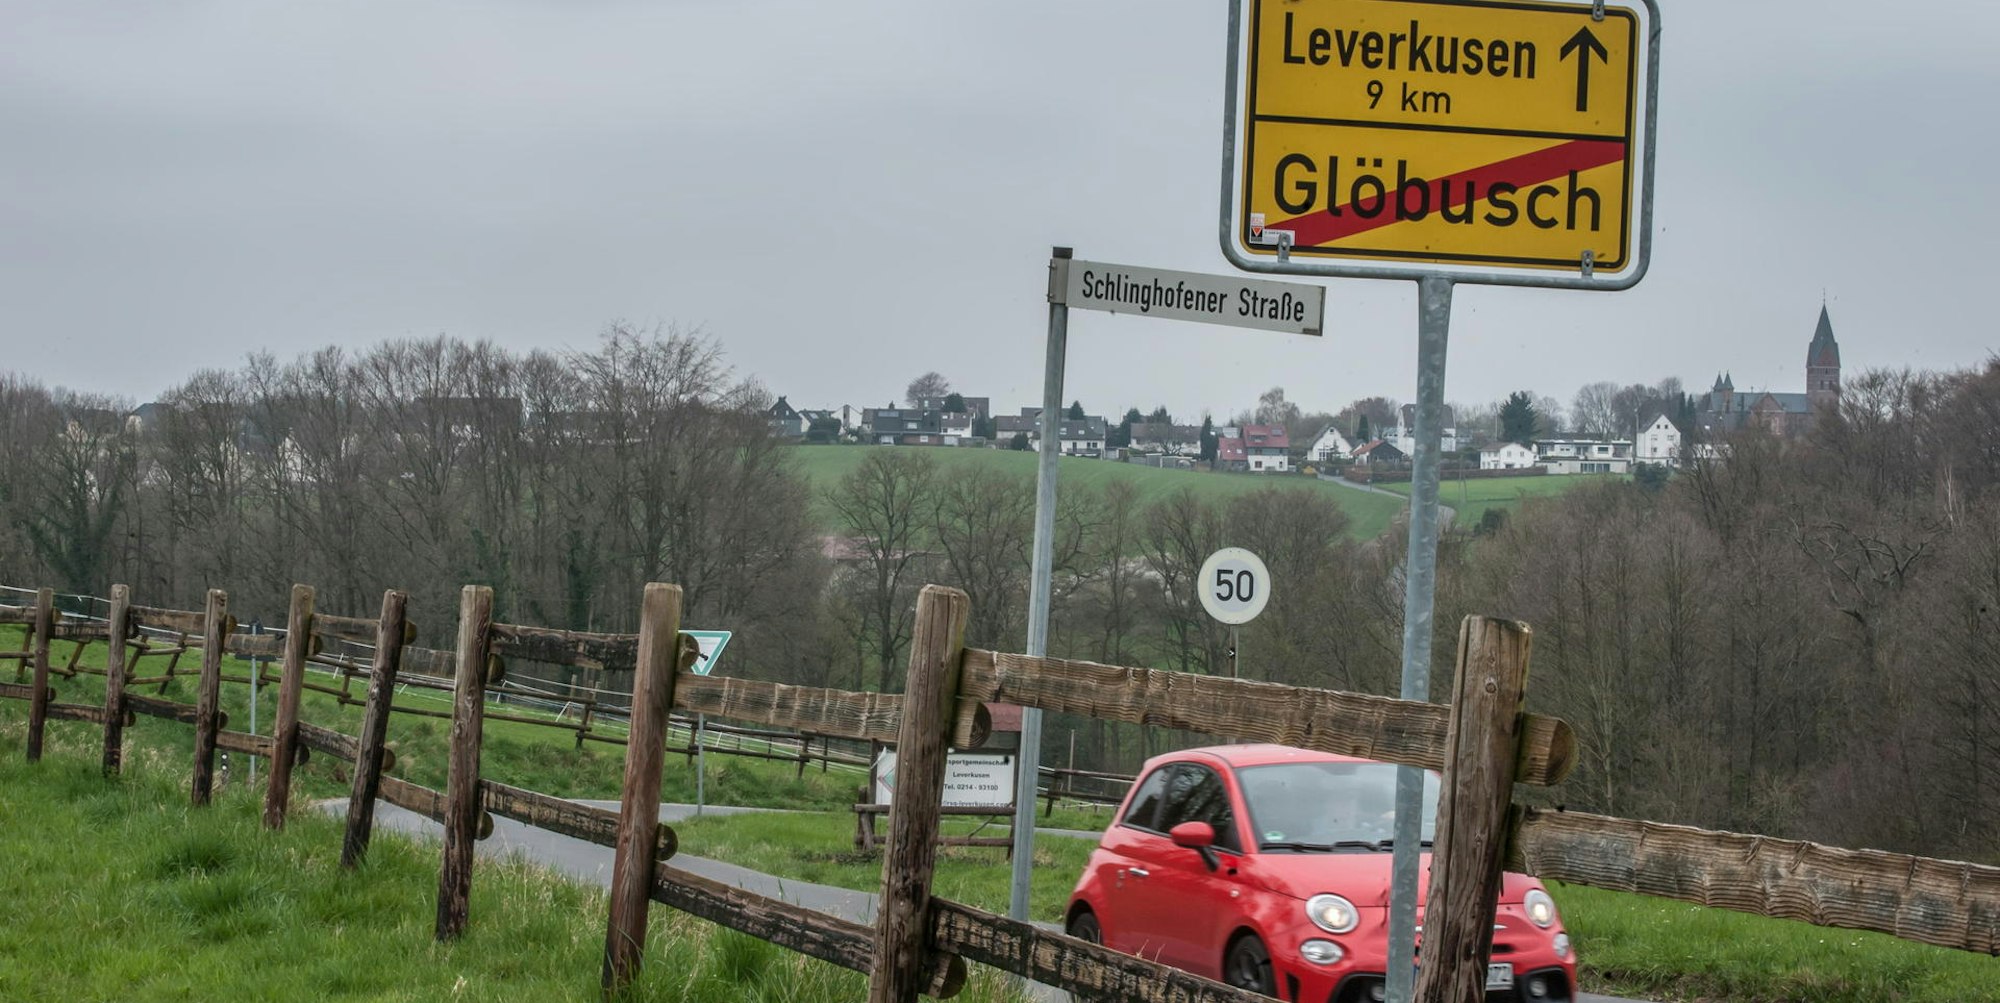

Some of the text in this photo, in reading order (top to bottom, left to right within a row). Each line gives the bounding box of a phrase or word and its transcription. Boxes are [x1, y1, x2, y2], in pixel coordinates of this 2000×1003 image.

[1283, 11, 1537, 80] Leverkusen
[1366, 79, 1451, 115] 9 km
[1273, 152, 1602, 232] Glöbusch
[1082, 270, 1305, 323] Schlinghofener Straße
[1215, 568, 1254, 603] 50
